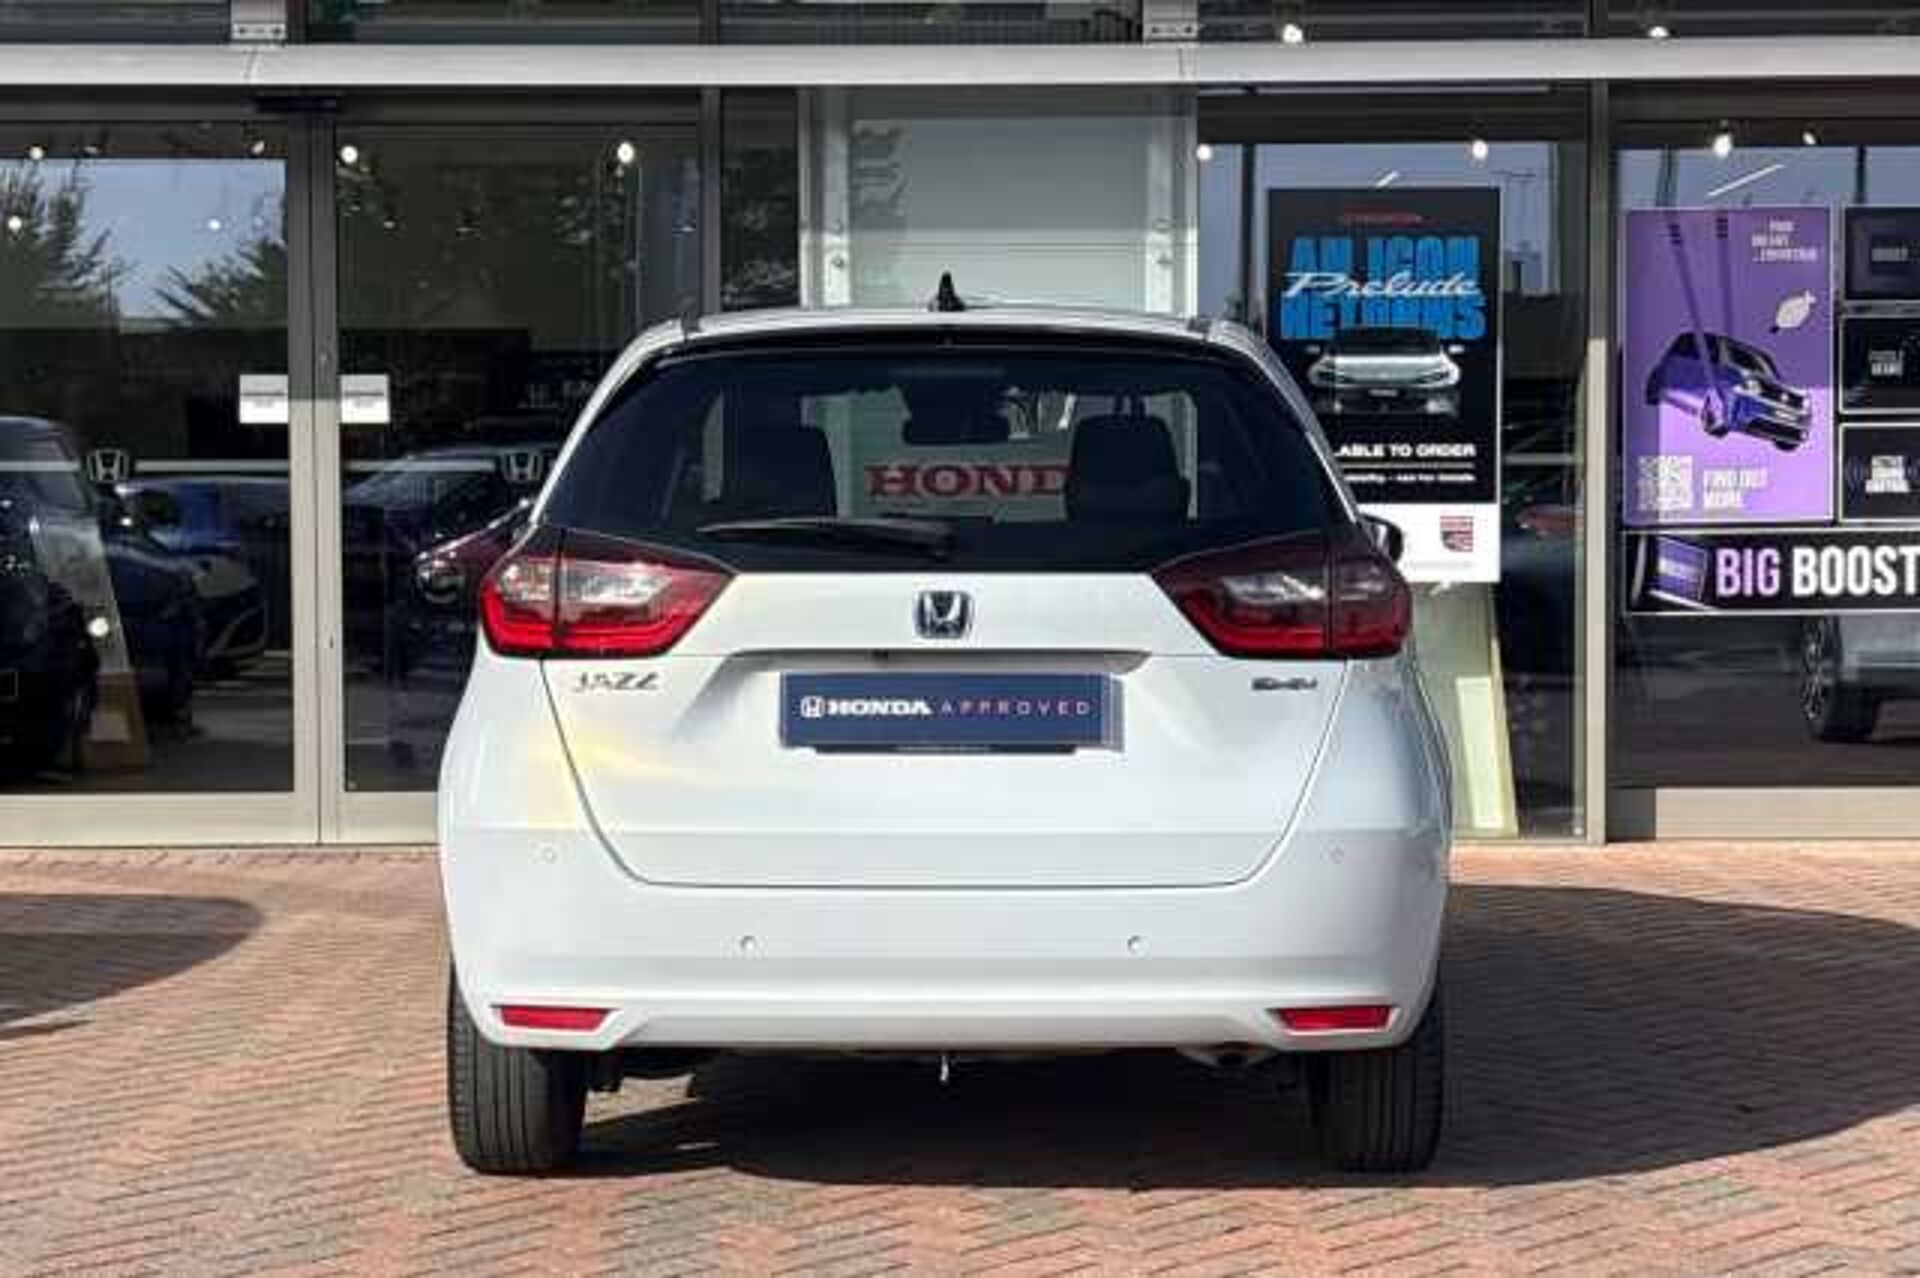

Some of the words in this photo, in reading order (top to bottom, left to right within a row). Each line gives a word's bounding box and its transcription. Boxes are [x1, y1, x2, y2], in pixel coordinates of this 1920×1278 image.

[1284, 269, 1482, 298] Prelude
[1334, 442, 1383, 457] ABLE
[1390, 442, 1413, 457] TO
[1416, 442, 1477, 457] ORDER
[1716, 547, 1781, 597] BIG
[1792, 545, 1920, 597] BOOST
[575, 671, 657, 692] JAZZ
[827, 698, 933, 716] HONDA
[940, 699, 1090, 716] APPROVED
